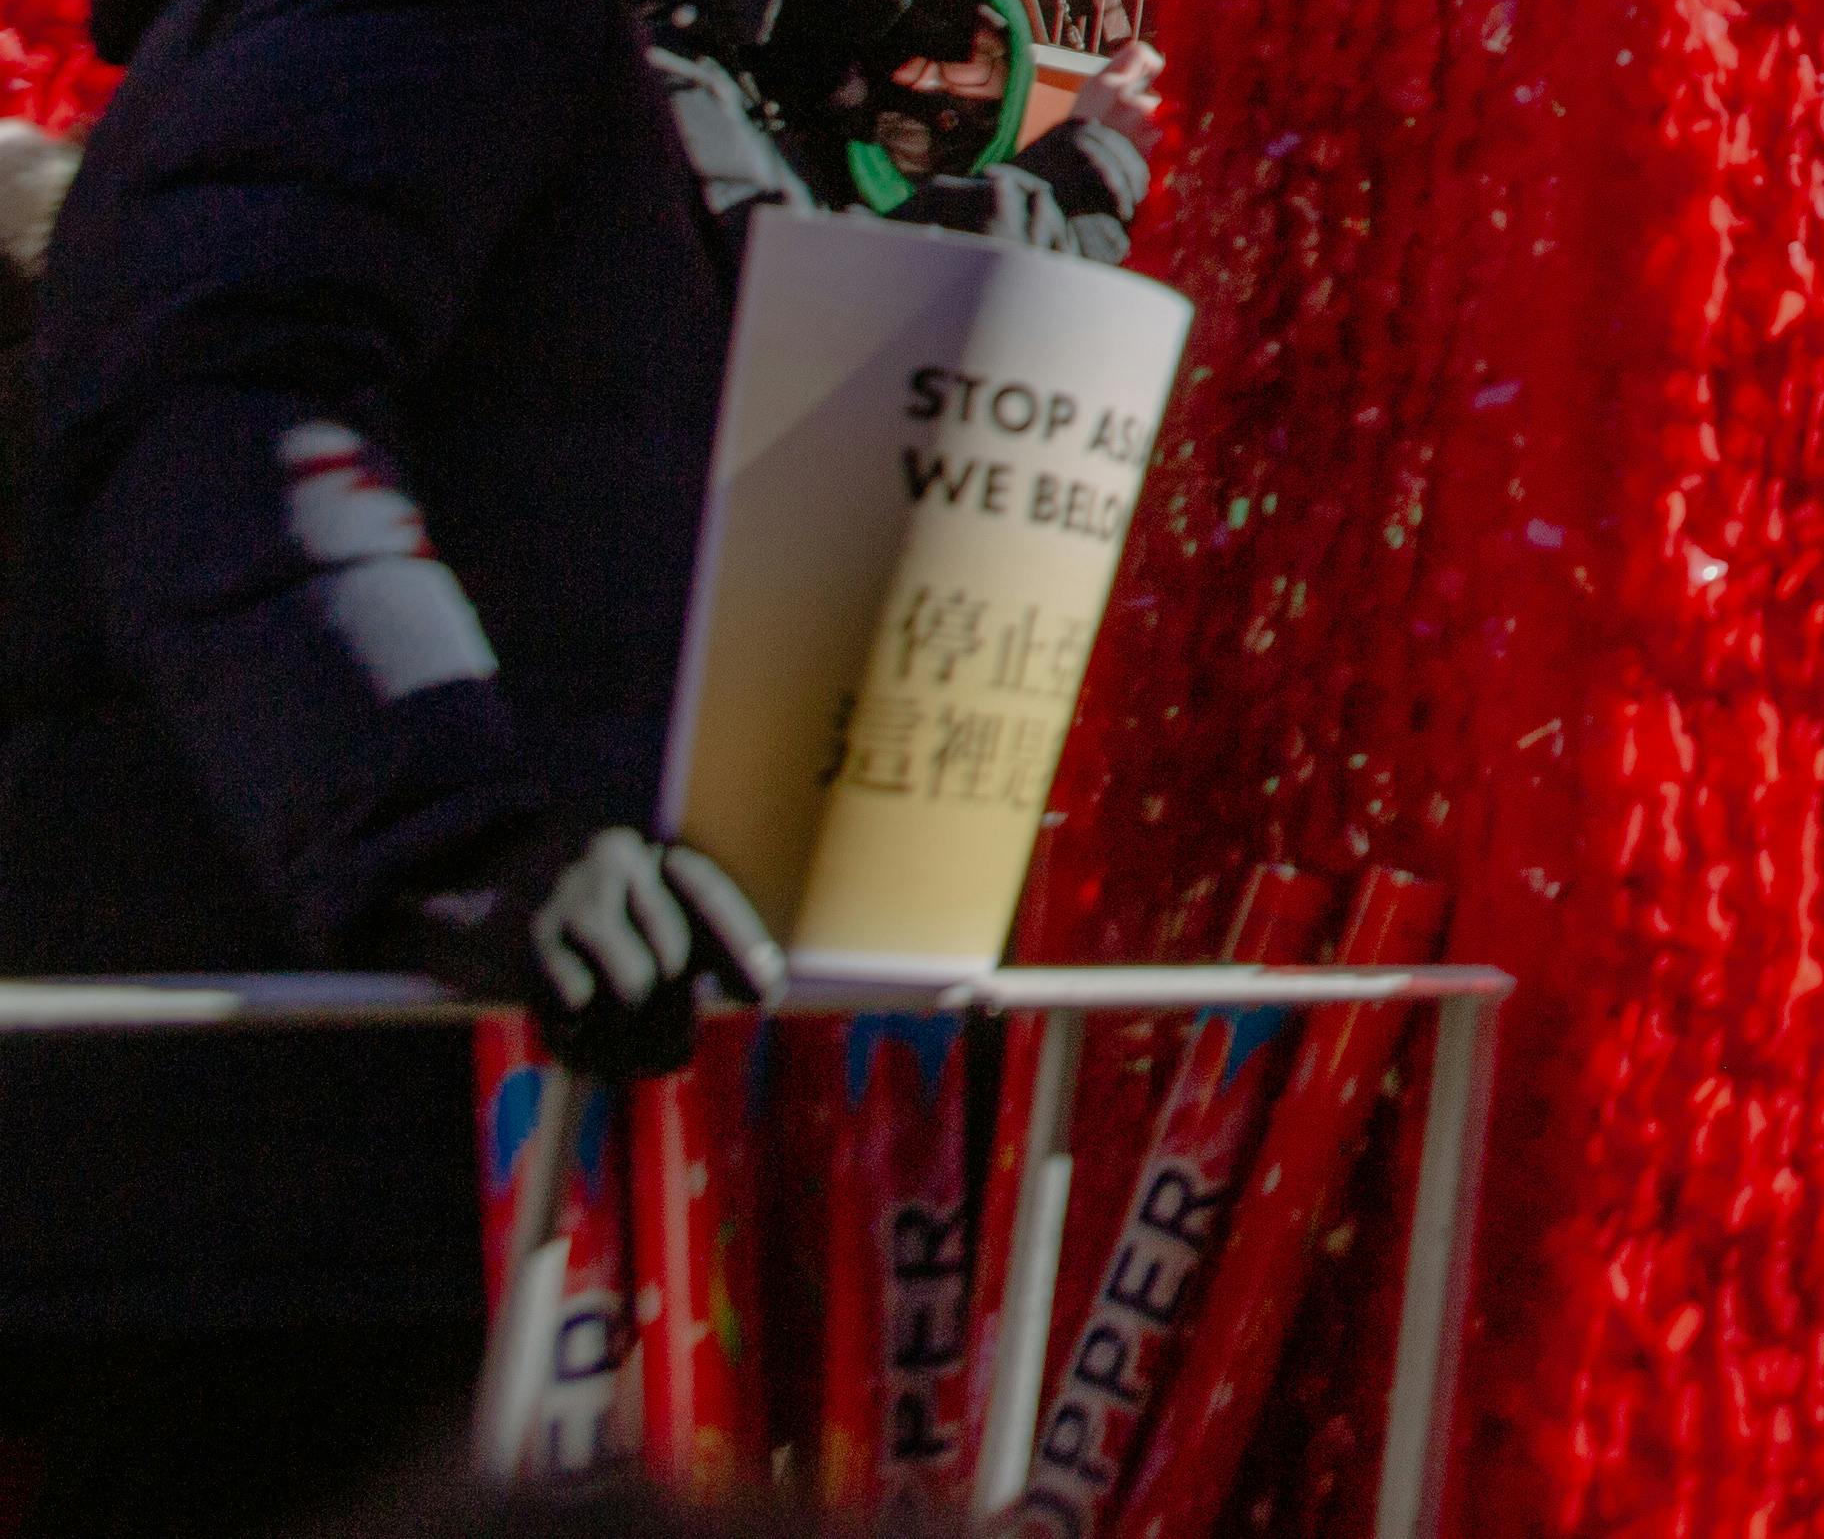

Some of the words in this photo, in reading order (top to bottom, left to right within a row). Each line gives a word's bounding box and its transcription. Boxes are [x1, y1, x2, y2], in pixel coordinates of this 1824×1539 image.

[903, 365, 1078, 441] STOP
[1086, 406, 1144, 463] AS
[904, 445, 1011, 514] WE
